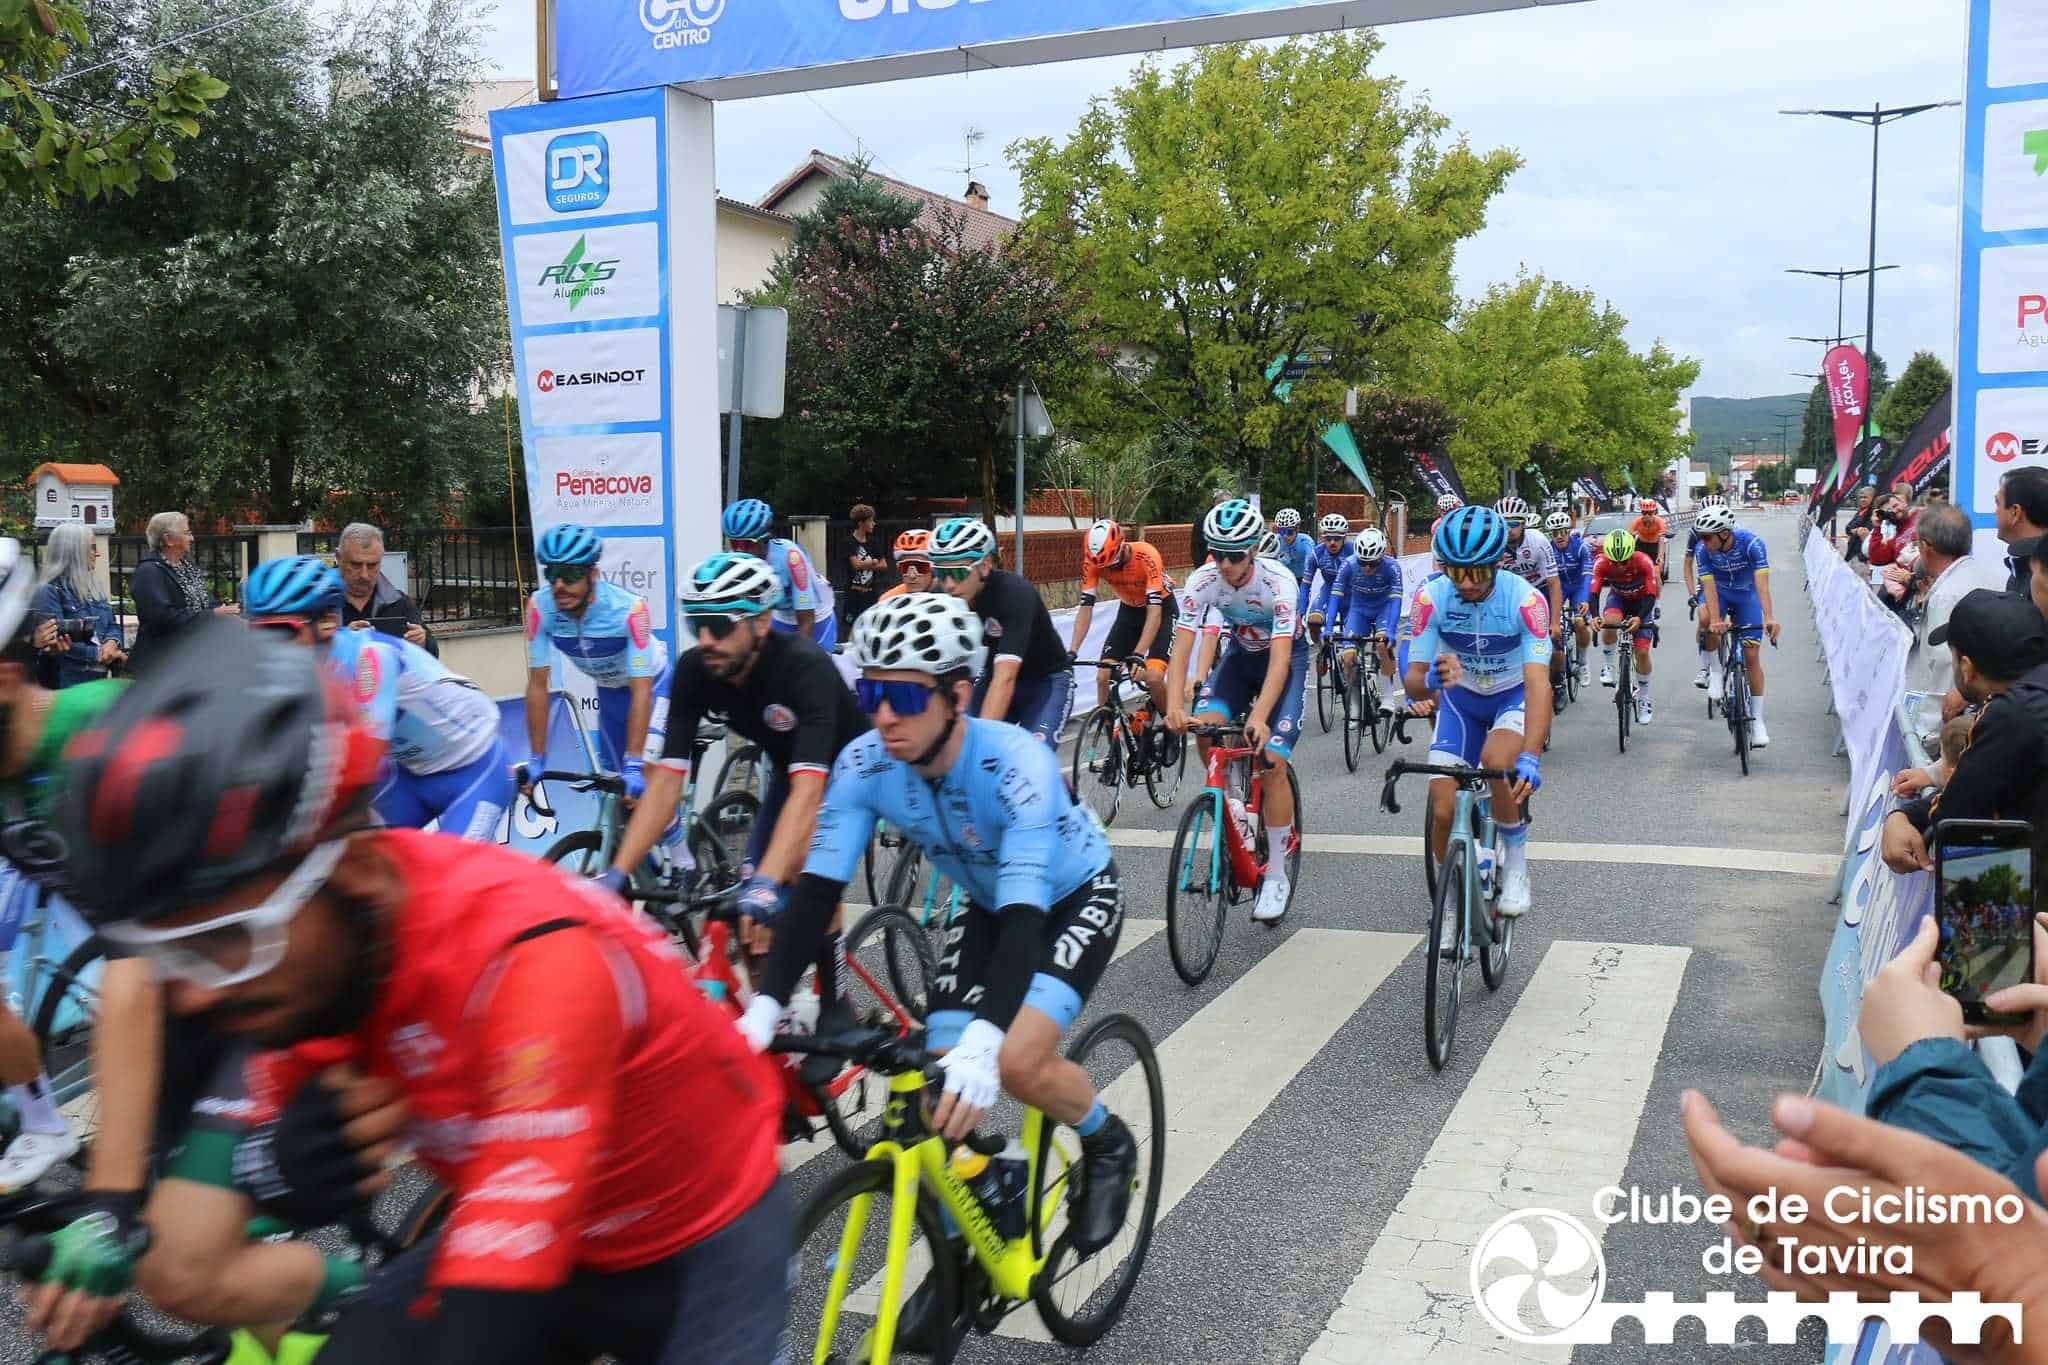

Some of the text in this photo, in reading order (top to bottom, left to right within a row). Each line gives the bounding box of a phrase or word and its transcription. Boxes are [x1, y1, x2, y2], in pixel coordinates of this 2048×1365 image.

[653, 27, 711, 50] CENTRO
[551, 144, 603, 191] DR
[555, 191, 600, 204] SEGUROS
[555, 472, 652, 497] Penacova
[602, 560, 657, 589] vfer
